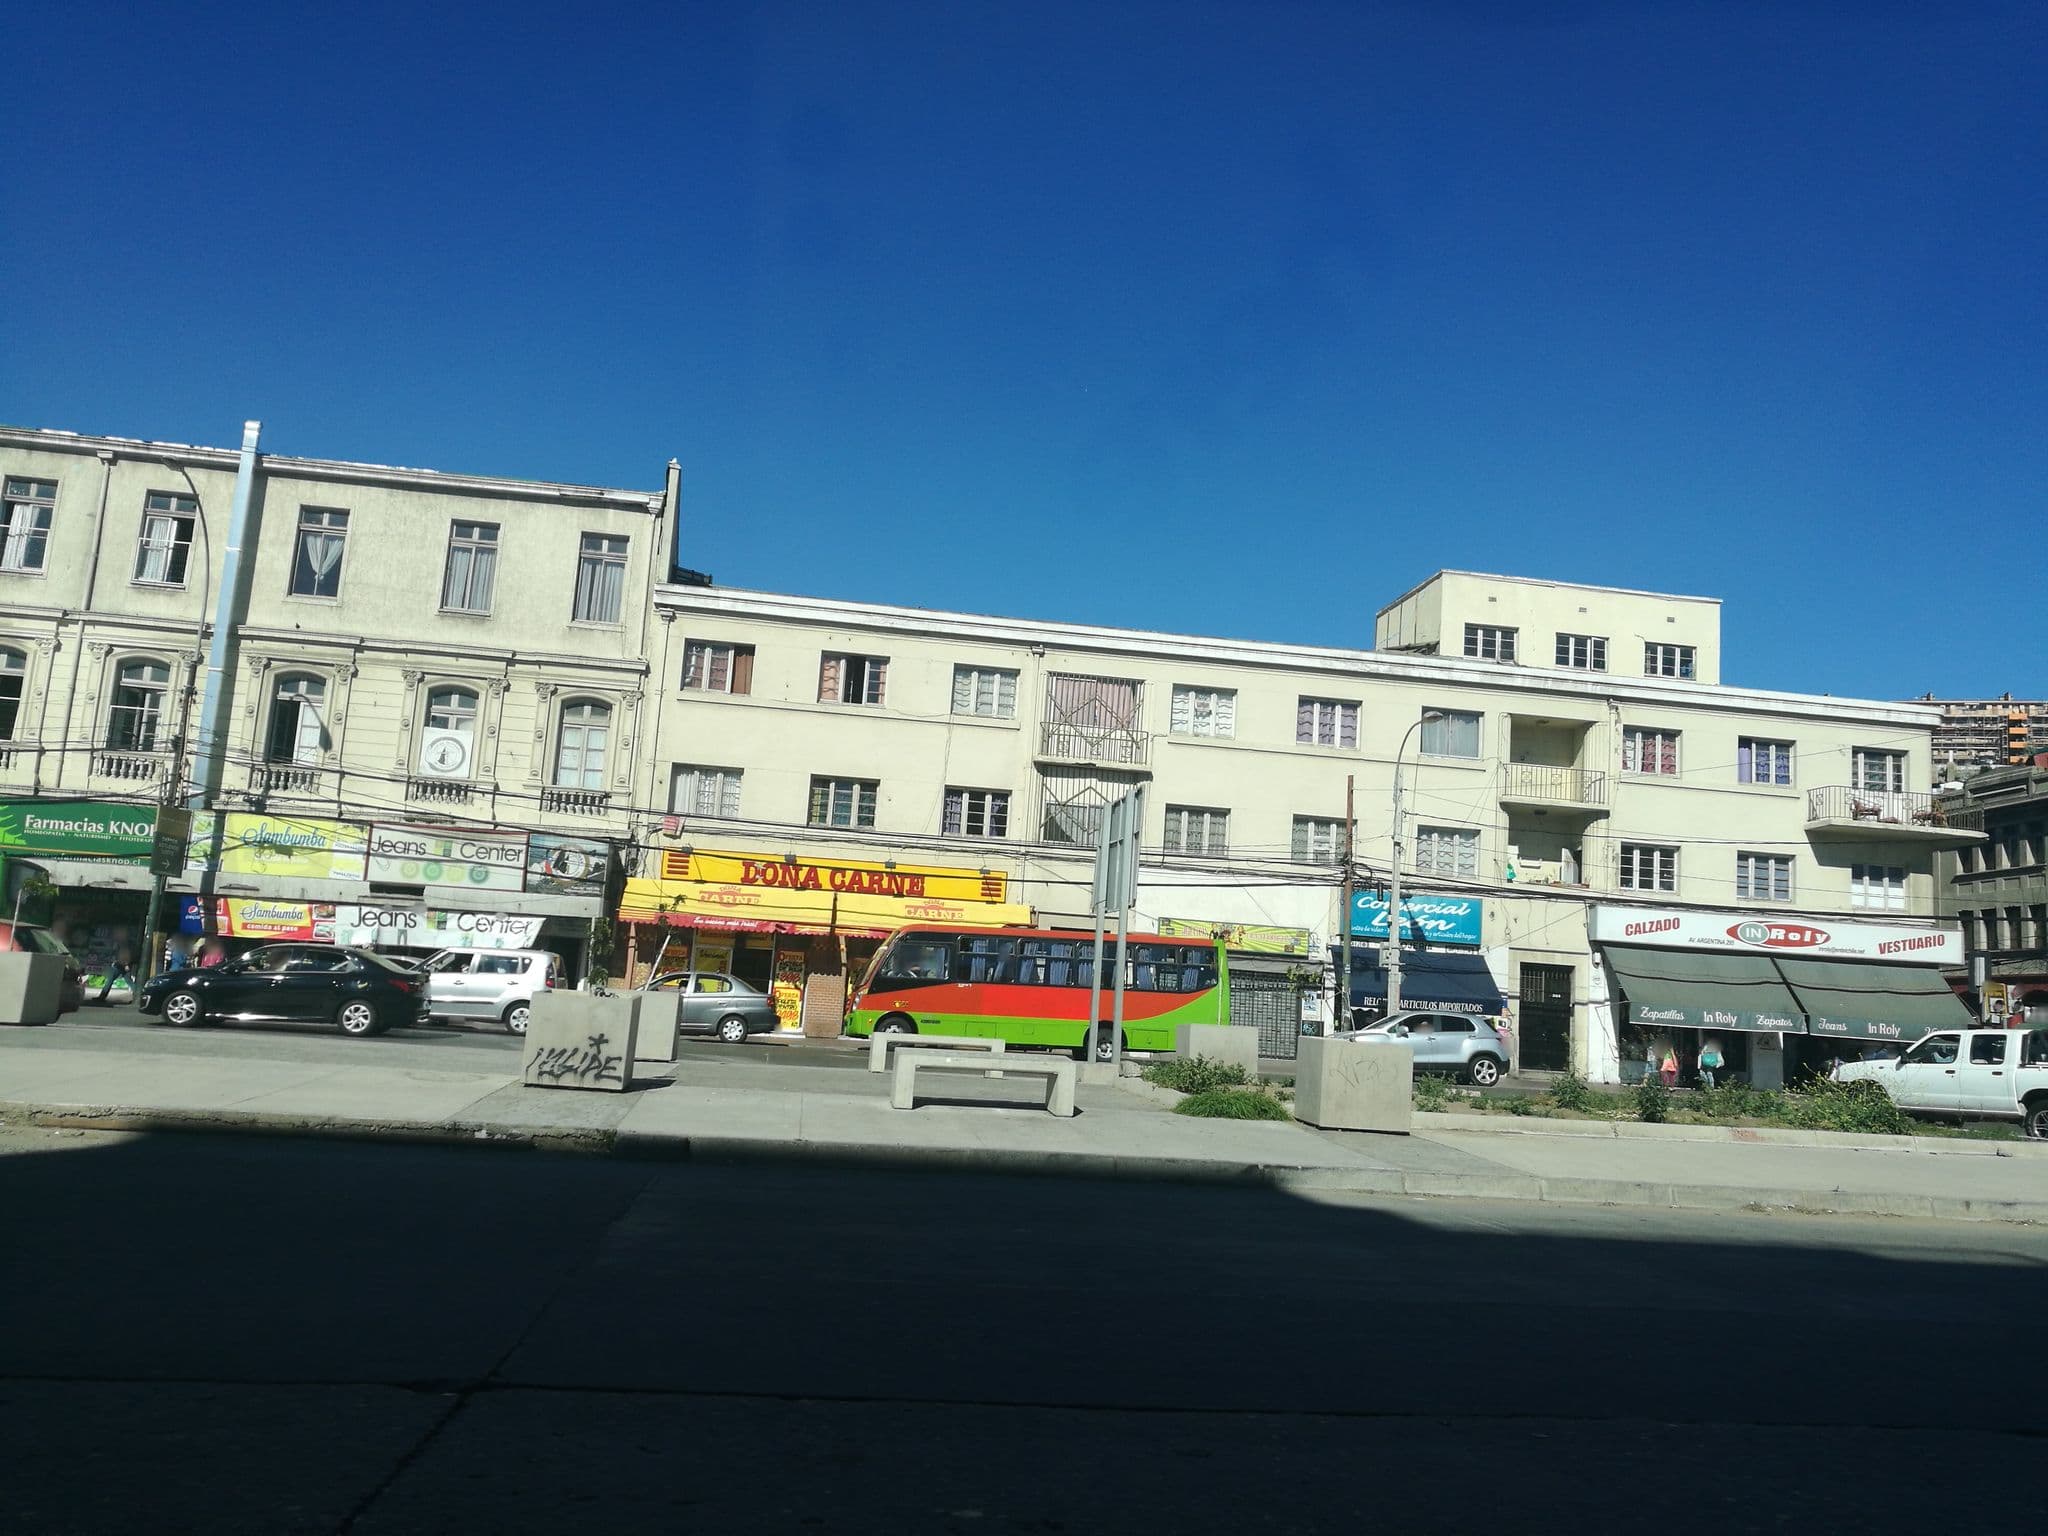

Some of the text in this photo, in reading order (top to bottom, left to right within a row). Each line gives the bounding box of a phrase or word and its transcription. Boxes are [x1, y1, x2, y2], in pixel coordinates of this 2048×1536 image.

[25, 814, 104, 833] Farmacias
[239, 822, 327, 848] Sambumba
[371, 836, 523, 862] Jeans Center
[829, 869, 925, 897] CARNE
[699, 892, 761, 905] CARNE
[240, 902, 304, 921] Sambumba
[905, 906, 965, 920] CARNE
[351, 906, 533, 935] Jeans Center
[1625, 917, 1681, 936] CALZADO
[1745, 927, 1829, 944] IN Roly
[1878, 934, 1945, 955] VESTUARIO
[1400, 999, 1438, 1010] ARTICULOS
[1438, 1001, 1484, 1013] IMPORTADOS
[1640, 1006, 1685, 1021] Zapatillas
[1703, 1011, 1738, 1028] In Roly
[1756, 1014, 1793, 1028] Zapatos
[1818, 1017, 1848, 1031] Jeans
[1868, 1022, 1900, 1038] In Roly
